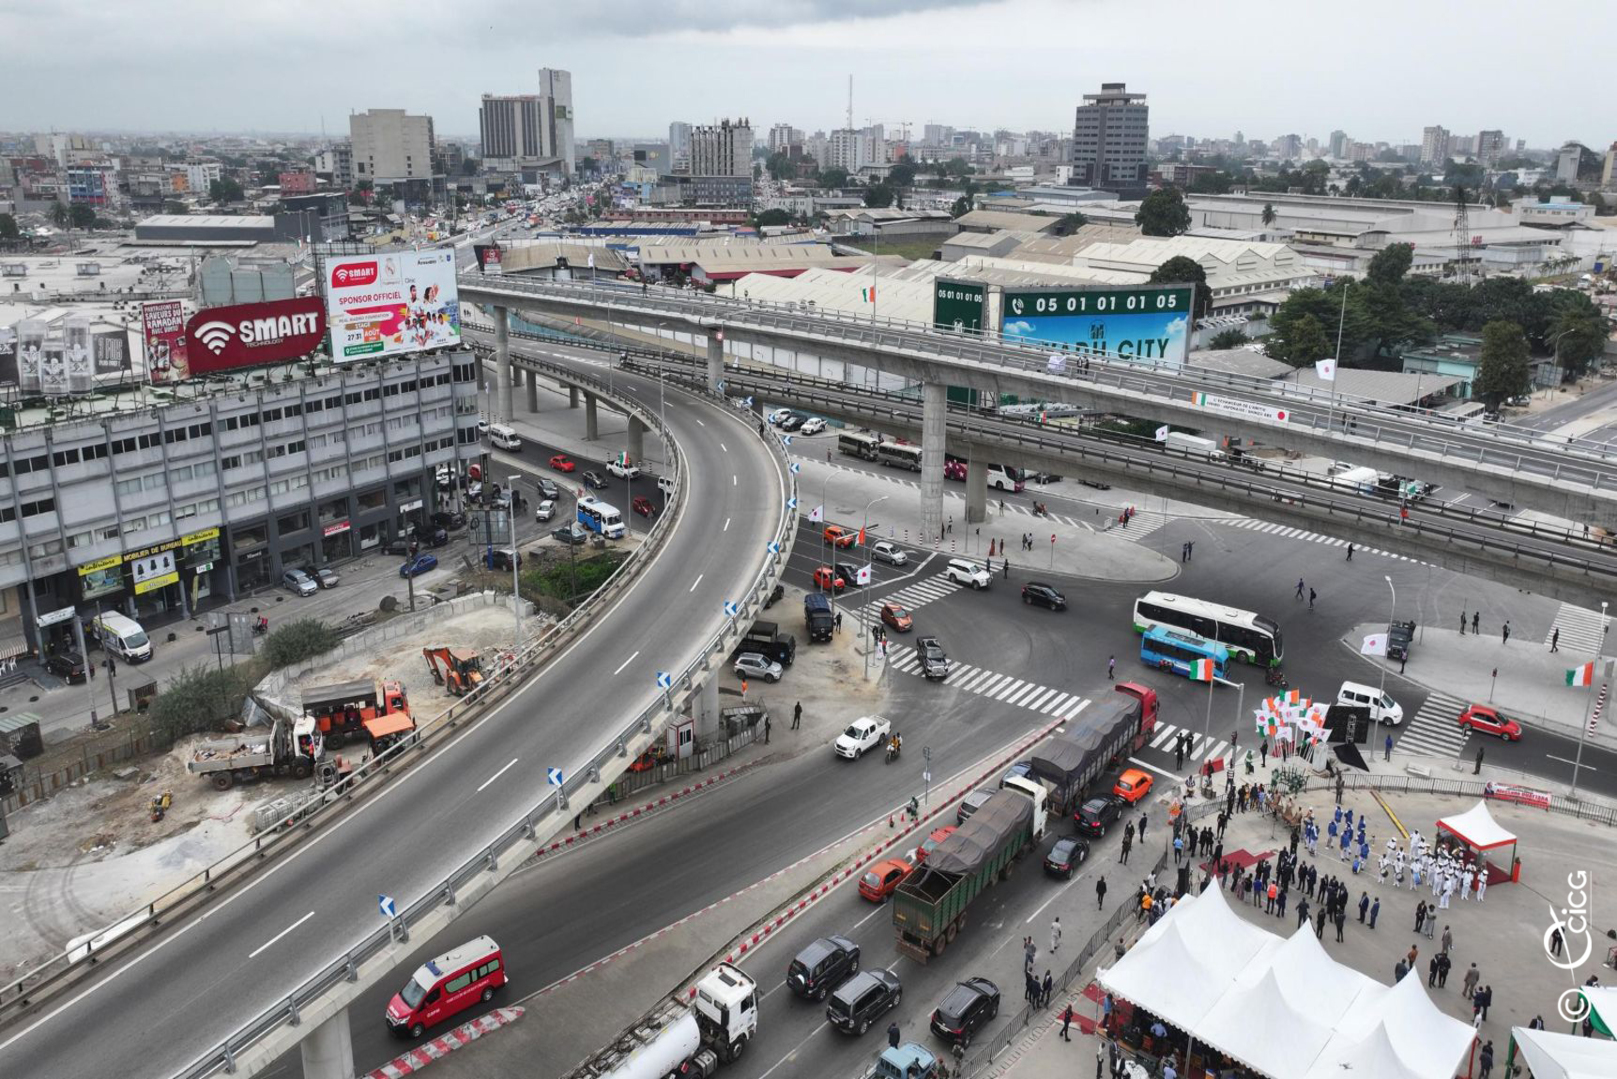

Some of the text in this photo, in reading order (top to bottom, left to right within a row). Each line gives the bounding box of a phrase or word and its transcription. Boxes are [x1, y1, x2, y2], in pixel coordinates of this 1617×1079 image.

[349, 267, 375, 278] SMART
[339, 291, 402, 305] SPONSOR OFFICIEL
[938, 289, 983, 303] 05 01 01 01 05
[1036, 294, 1177, 312] 05 01 01 01 05
[145, 308, 181, 320] SAVEURS DU
[147, 317, 182, 329] RAMADAN
[239, 312, 318, 343] SMART
[245, 338, 284, 348] TECHNOLOGY
[1117, 337, 1170, 360] CITY
[123, 540, 182, 562] MOBILIER DE BUREAU
